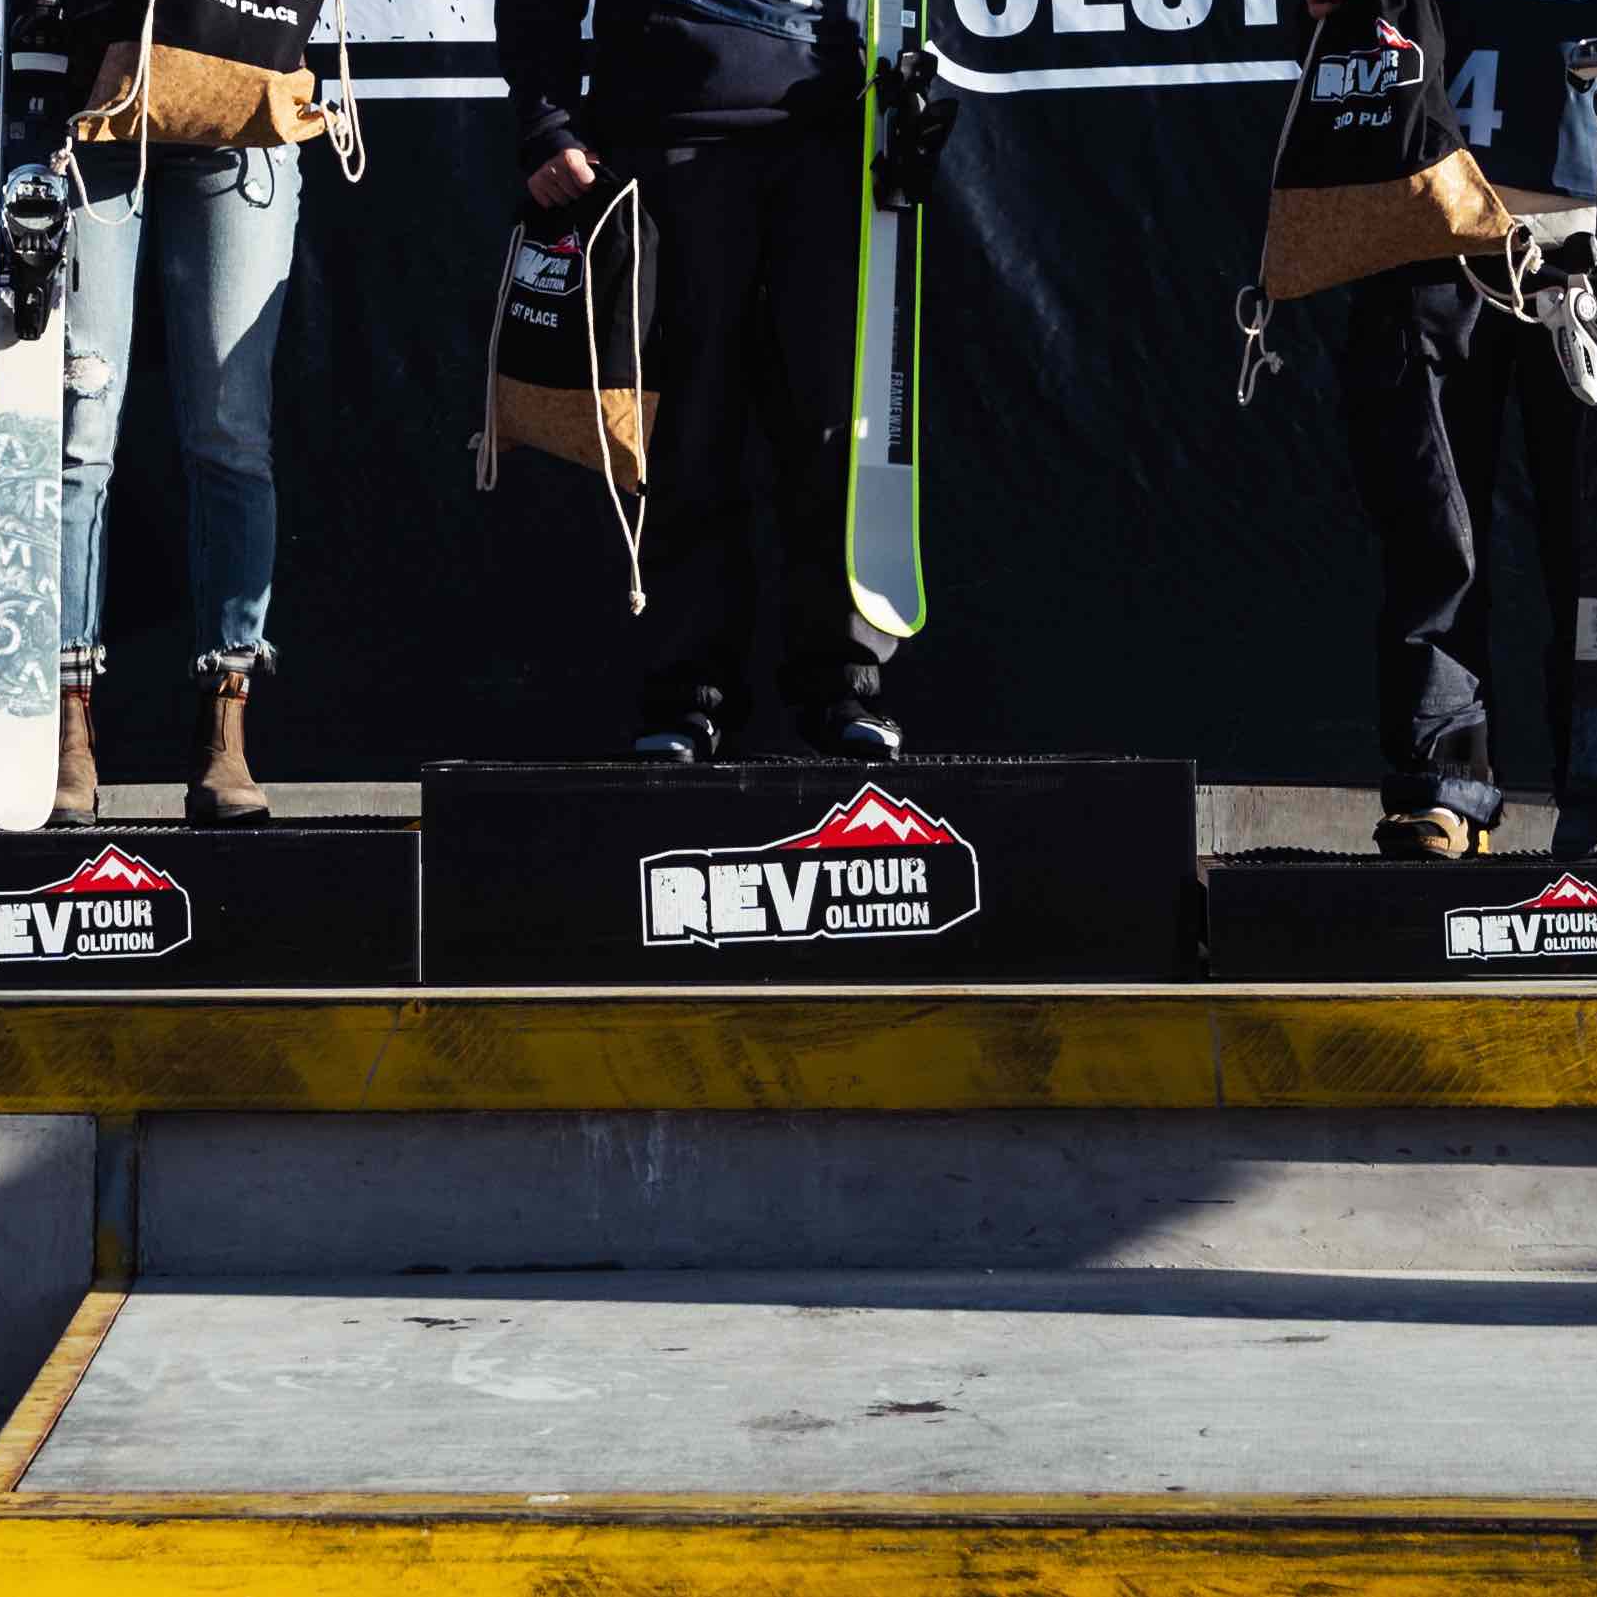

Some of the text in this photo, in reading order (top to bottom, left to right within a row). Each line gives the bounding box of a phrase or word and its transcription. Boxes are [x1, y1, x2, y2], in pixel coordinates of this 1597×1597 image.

[240, 0, 299, 26] PLACE
[1444, 48, 1503, 148] 4
[523, 306, 559, 328] PLACE
[650, 857, 928, 936] REV TOUR
[75, 898, 153, 929] TOUR
[825, 901, 930, 930] OLUTION
[76, 931, 154, 953] OLUTION
[1450, 913, 1542, 955] REV
